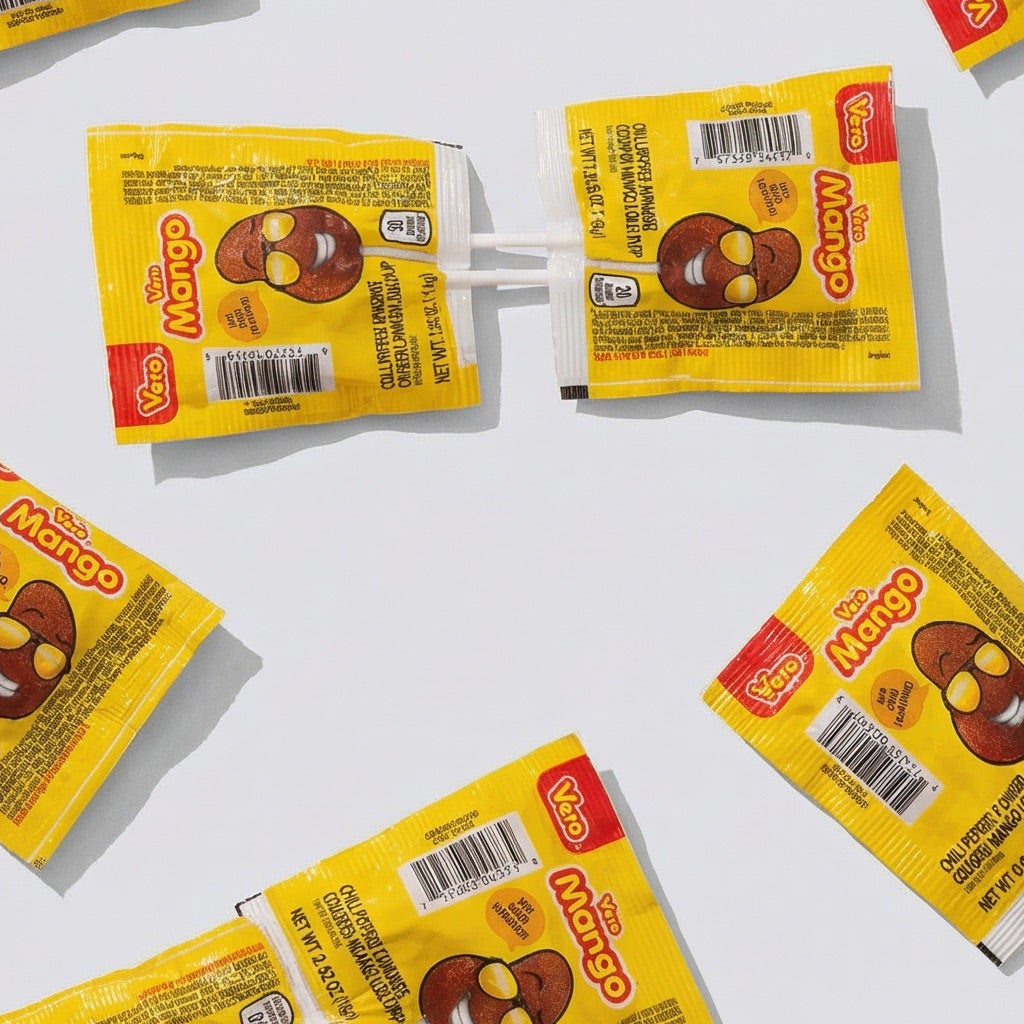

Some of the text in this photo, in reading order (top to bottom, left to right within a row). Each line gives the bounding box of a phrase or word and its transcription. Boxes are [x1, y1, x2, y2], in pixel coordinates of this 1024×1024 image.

[847, 97, 869, 148] Vero
[815, 172, 852, 297] Mango
[162, 216, 201, 337] Mango
[431, 362, 451, 385] NET
[2, 500, 122, 593] Mango
[827, 569, 921, 676] Mango
[552, 780, 583, 836] Vero
[290, 906, 312, 932] NET
[977, 870, 1017, 914] NET WT
[300, 930, 324, 954] WT
[551, 869, 630, 1002] Mango
